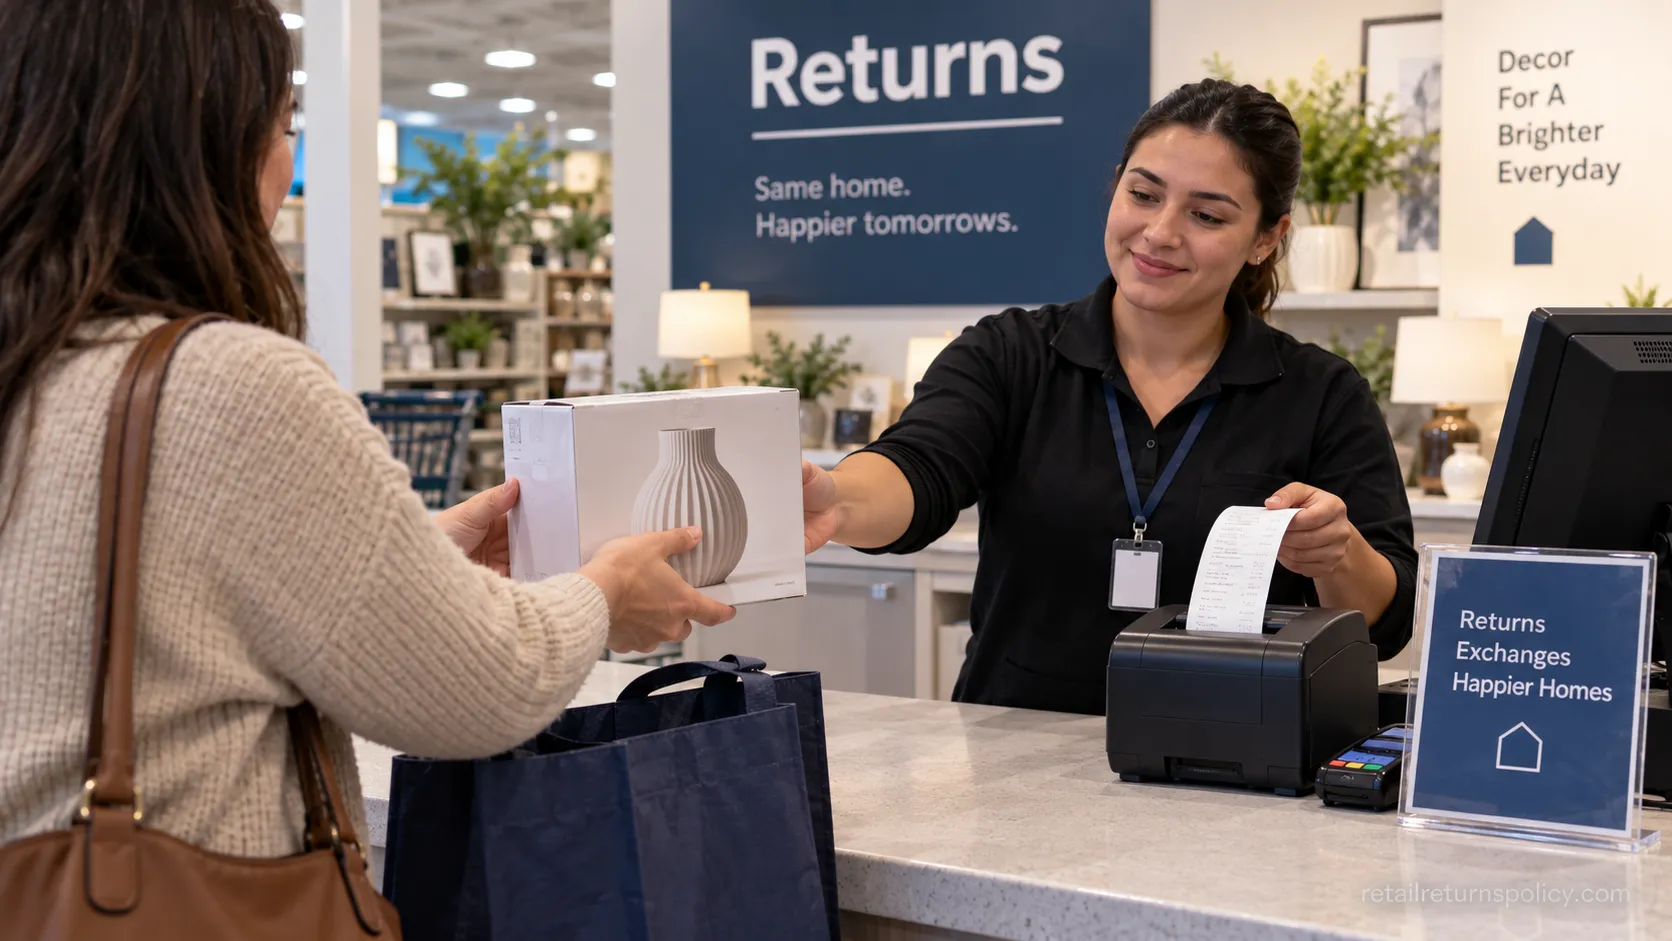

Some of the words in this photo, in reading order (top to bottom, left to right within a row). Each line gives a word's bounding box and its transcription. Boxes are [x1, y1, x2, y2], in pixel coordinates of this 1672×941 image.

[751, 34, 1065, 109] Returns
[1498, 49, 1574, 73] Decor
[1498, 86, 1539, 110] For
[1547, 82, 1565, 106] A
[1498, 121, 1604, 151] Brighter
[754, 175, 824, 201] Same
[830, 172, 911, 199] home.
[1498, 157, 1621, 188] Everyday
[755, 210, 857, 244] Happier
[864, 211, 1019, 236] tomorrows.
[1460, 609, 1546, 633] Returns
[1456, 640, 1572, 670] Exchanges
[1452, 671, 1534, 699] Happier
[1539, 677, 1613, 702] Homes
